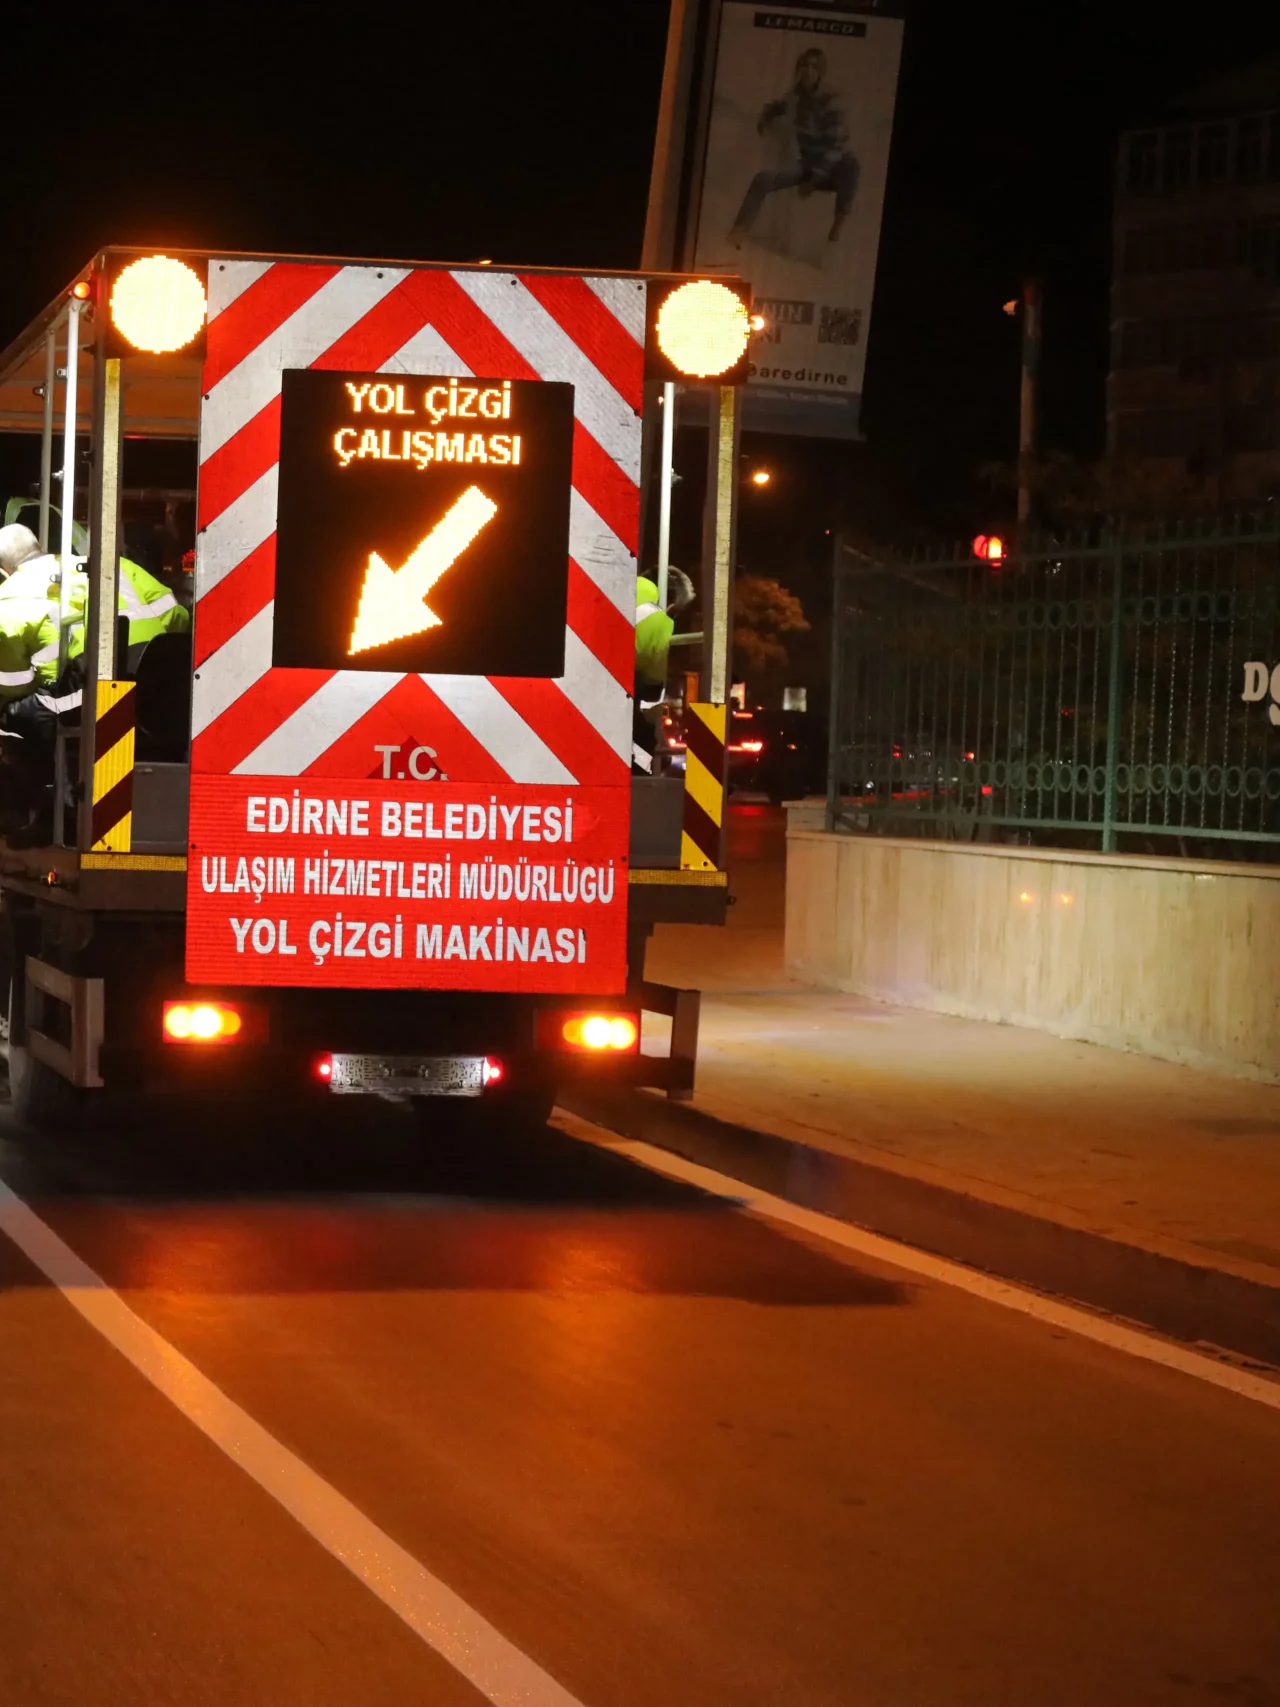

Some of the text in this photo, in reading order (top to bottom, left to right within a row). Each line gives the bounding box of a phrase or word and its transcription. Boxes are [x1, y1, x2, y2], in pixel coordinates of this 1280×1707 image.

[345, 378, 512, 424] YOL ÇİZGİ
[334, 428, 521, 470] ÇALIŞMASI
[374, 744, 448, 781] T.C.
[246, 788, 573, 843] EDİRNE BELEDİYESİ
[201, 855, 295, 904] ULAŞIM
[303, 849, 451, 899] HİZMETLERİ
[228, 911, 586, 966] YOL ÇİZGİ MAKİNASI
